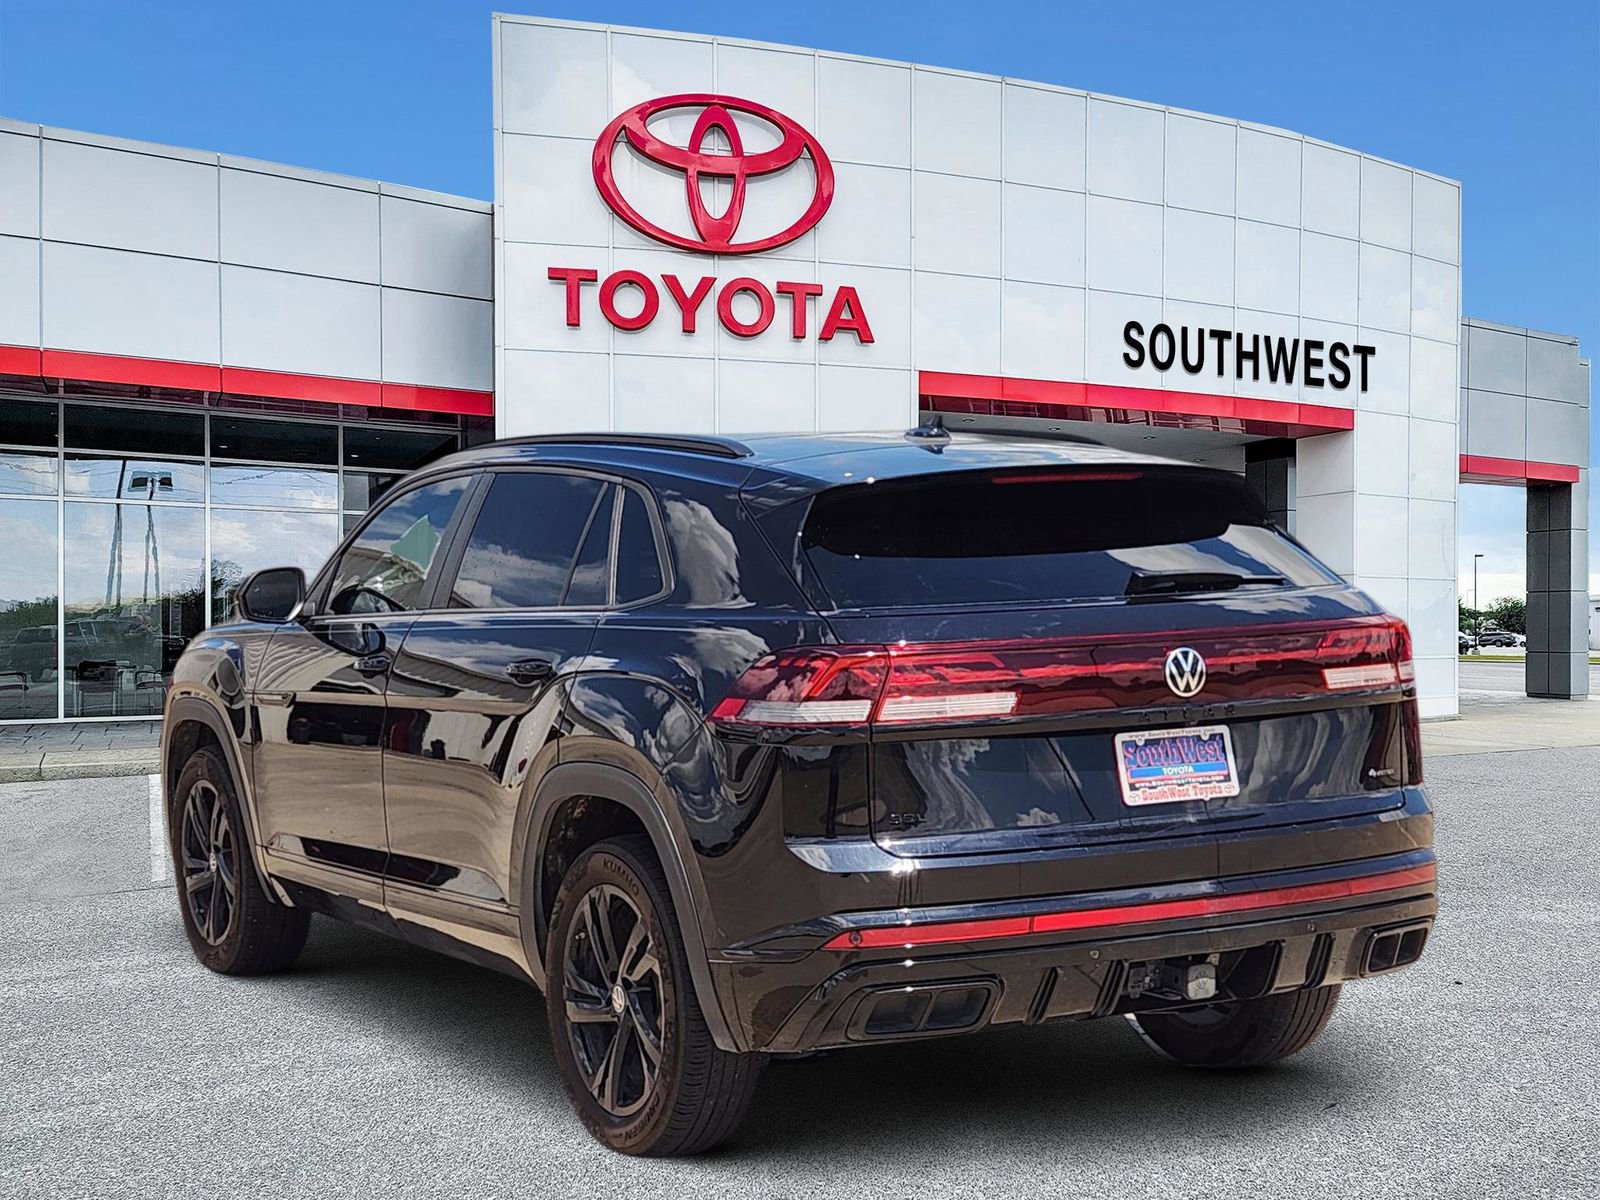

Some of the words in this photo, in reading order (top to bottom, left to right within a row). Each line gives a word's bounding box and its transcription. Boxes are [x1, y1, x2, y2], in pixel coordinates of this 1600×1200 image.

[548, 267, 875, 344] TOYOTA
[1122, 320, 1376, 392] SOUTHWEST
[1162, 766, 1194, 776] TOYOTA
[1191, 783, 1223, 798] Toyota
[603, 858, 640, 896] KUMHO
